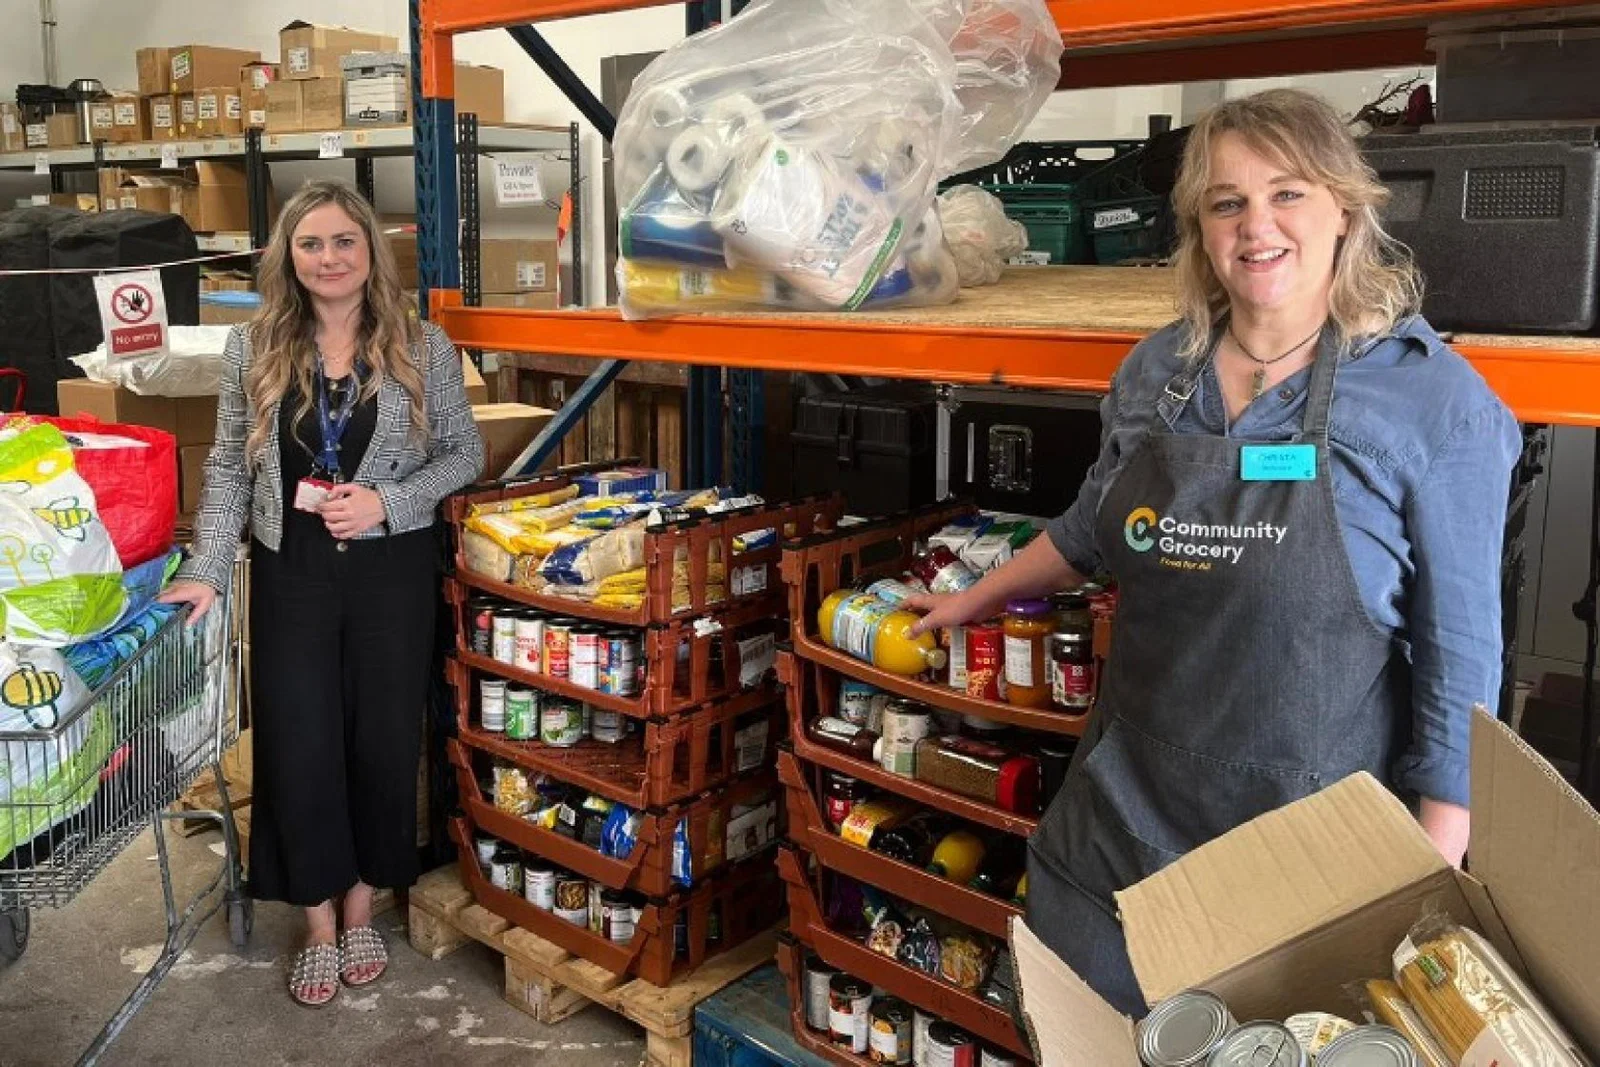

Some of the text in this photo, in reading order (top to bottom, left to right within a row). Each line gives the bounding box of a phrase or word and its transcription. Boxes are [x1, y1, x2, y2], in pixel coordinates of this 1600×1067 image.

[115, 335, 131, 345] No
[1158, 516, 1288, 544] Community
[1158, 537, 1245, 563] Grocery
